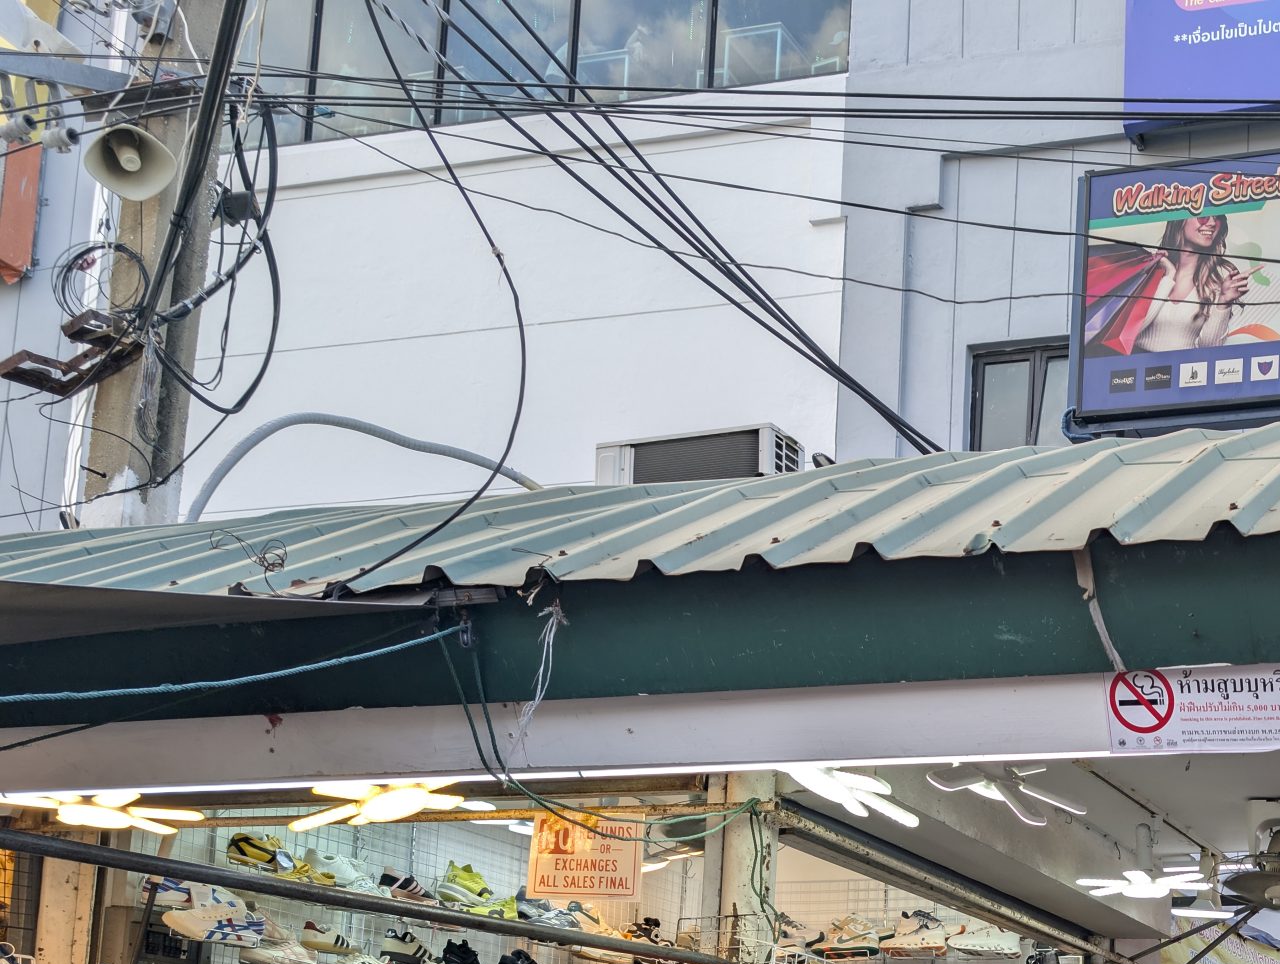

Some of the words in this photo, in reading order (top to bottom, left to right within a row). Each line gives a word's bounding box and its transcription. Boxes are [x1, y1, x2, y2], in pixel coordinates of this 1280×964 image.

[1113, 182, 1206, 216] Walking
[1246, 704, 1268, 713] 5,000
[599, 843, 612, 854] OR
[554, 857, 618, 873] EXCHANGES
[538, 874, 559, 888] ALL
[562, 875, 595, 889] SALES
[598, 876, 631, 890] FINAL
